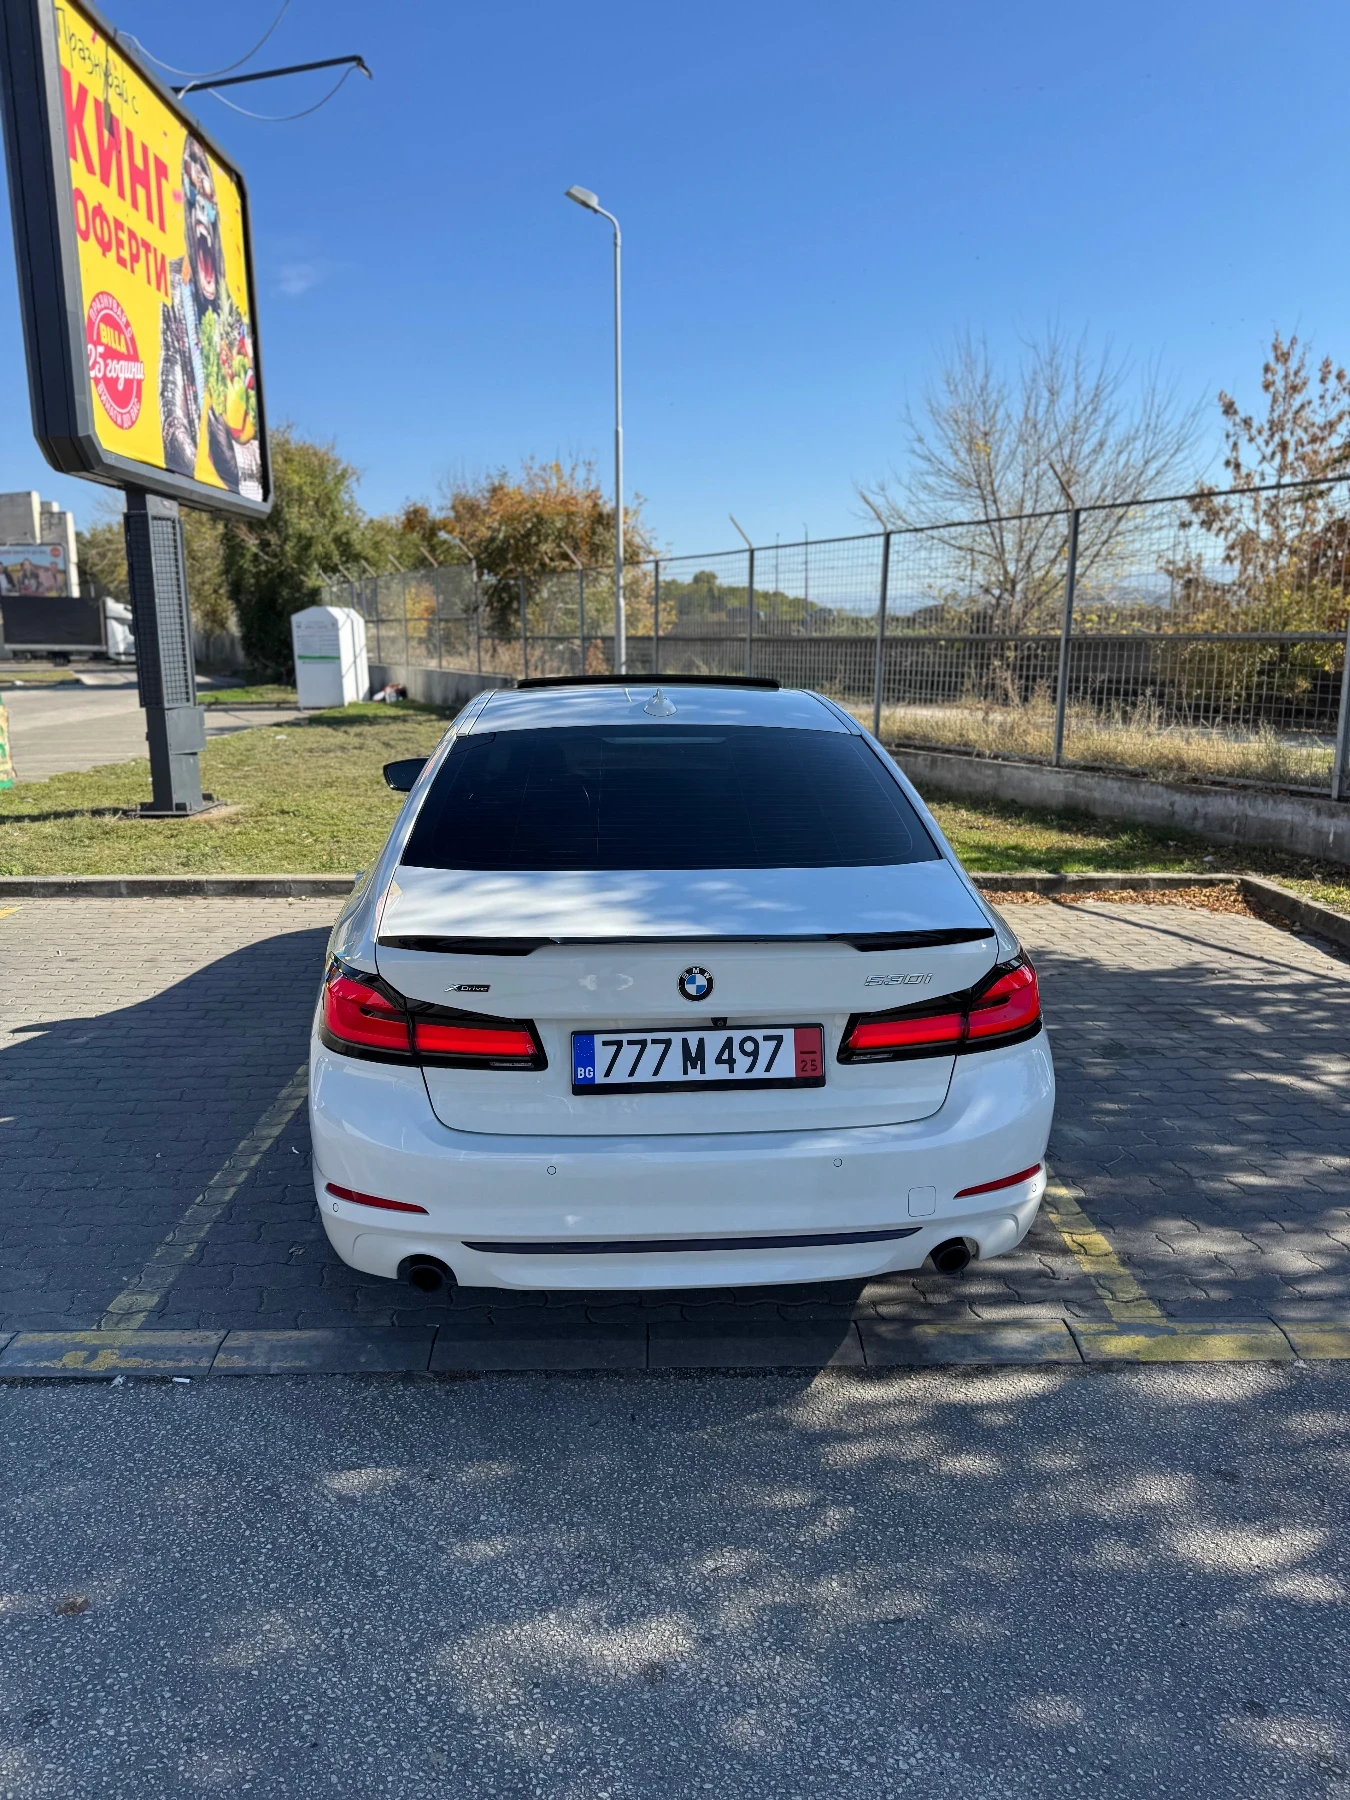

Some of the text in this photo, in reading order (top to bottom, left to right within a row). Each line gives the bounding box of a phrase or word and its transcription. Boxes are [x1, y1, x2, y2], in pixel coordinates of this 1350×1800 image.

[60, 64, 169, 235] КИНГ
[72, 187, 169, 298] ОФЕРТИ
[99, 321, 127, 355] BILLA
[87, 343, 105, 379] 25
[681, 967, 712, 980] BMW
[864, 973, 933, 986] 530i
[577, 1066, 594, 1079] BG
[601, 1034, 784, 1077] 777 M 497
[800, 1059, 818, 1073] 25
